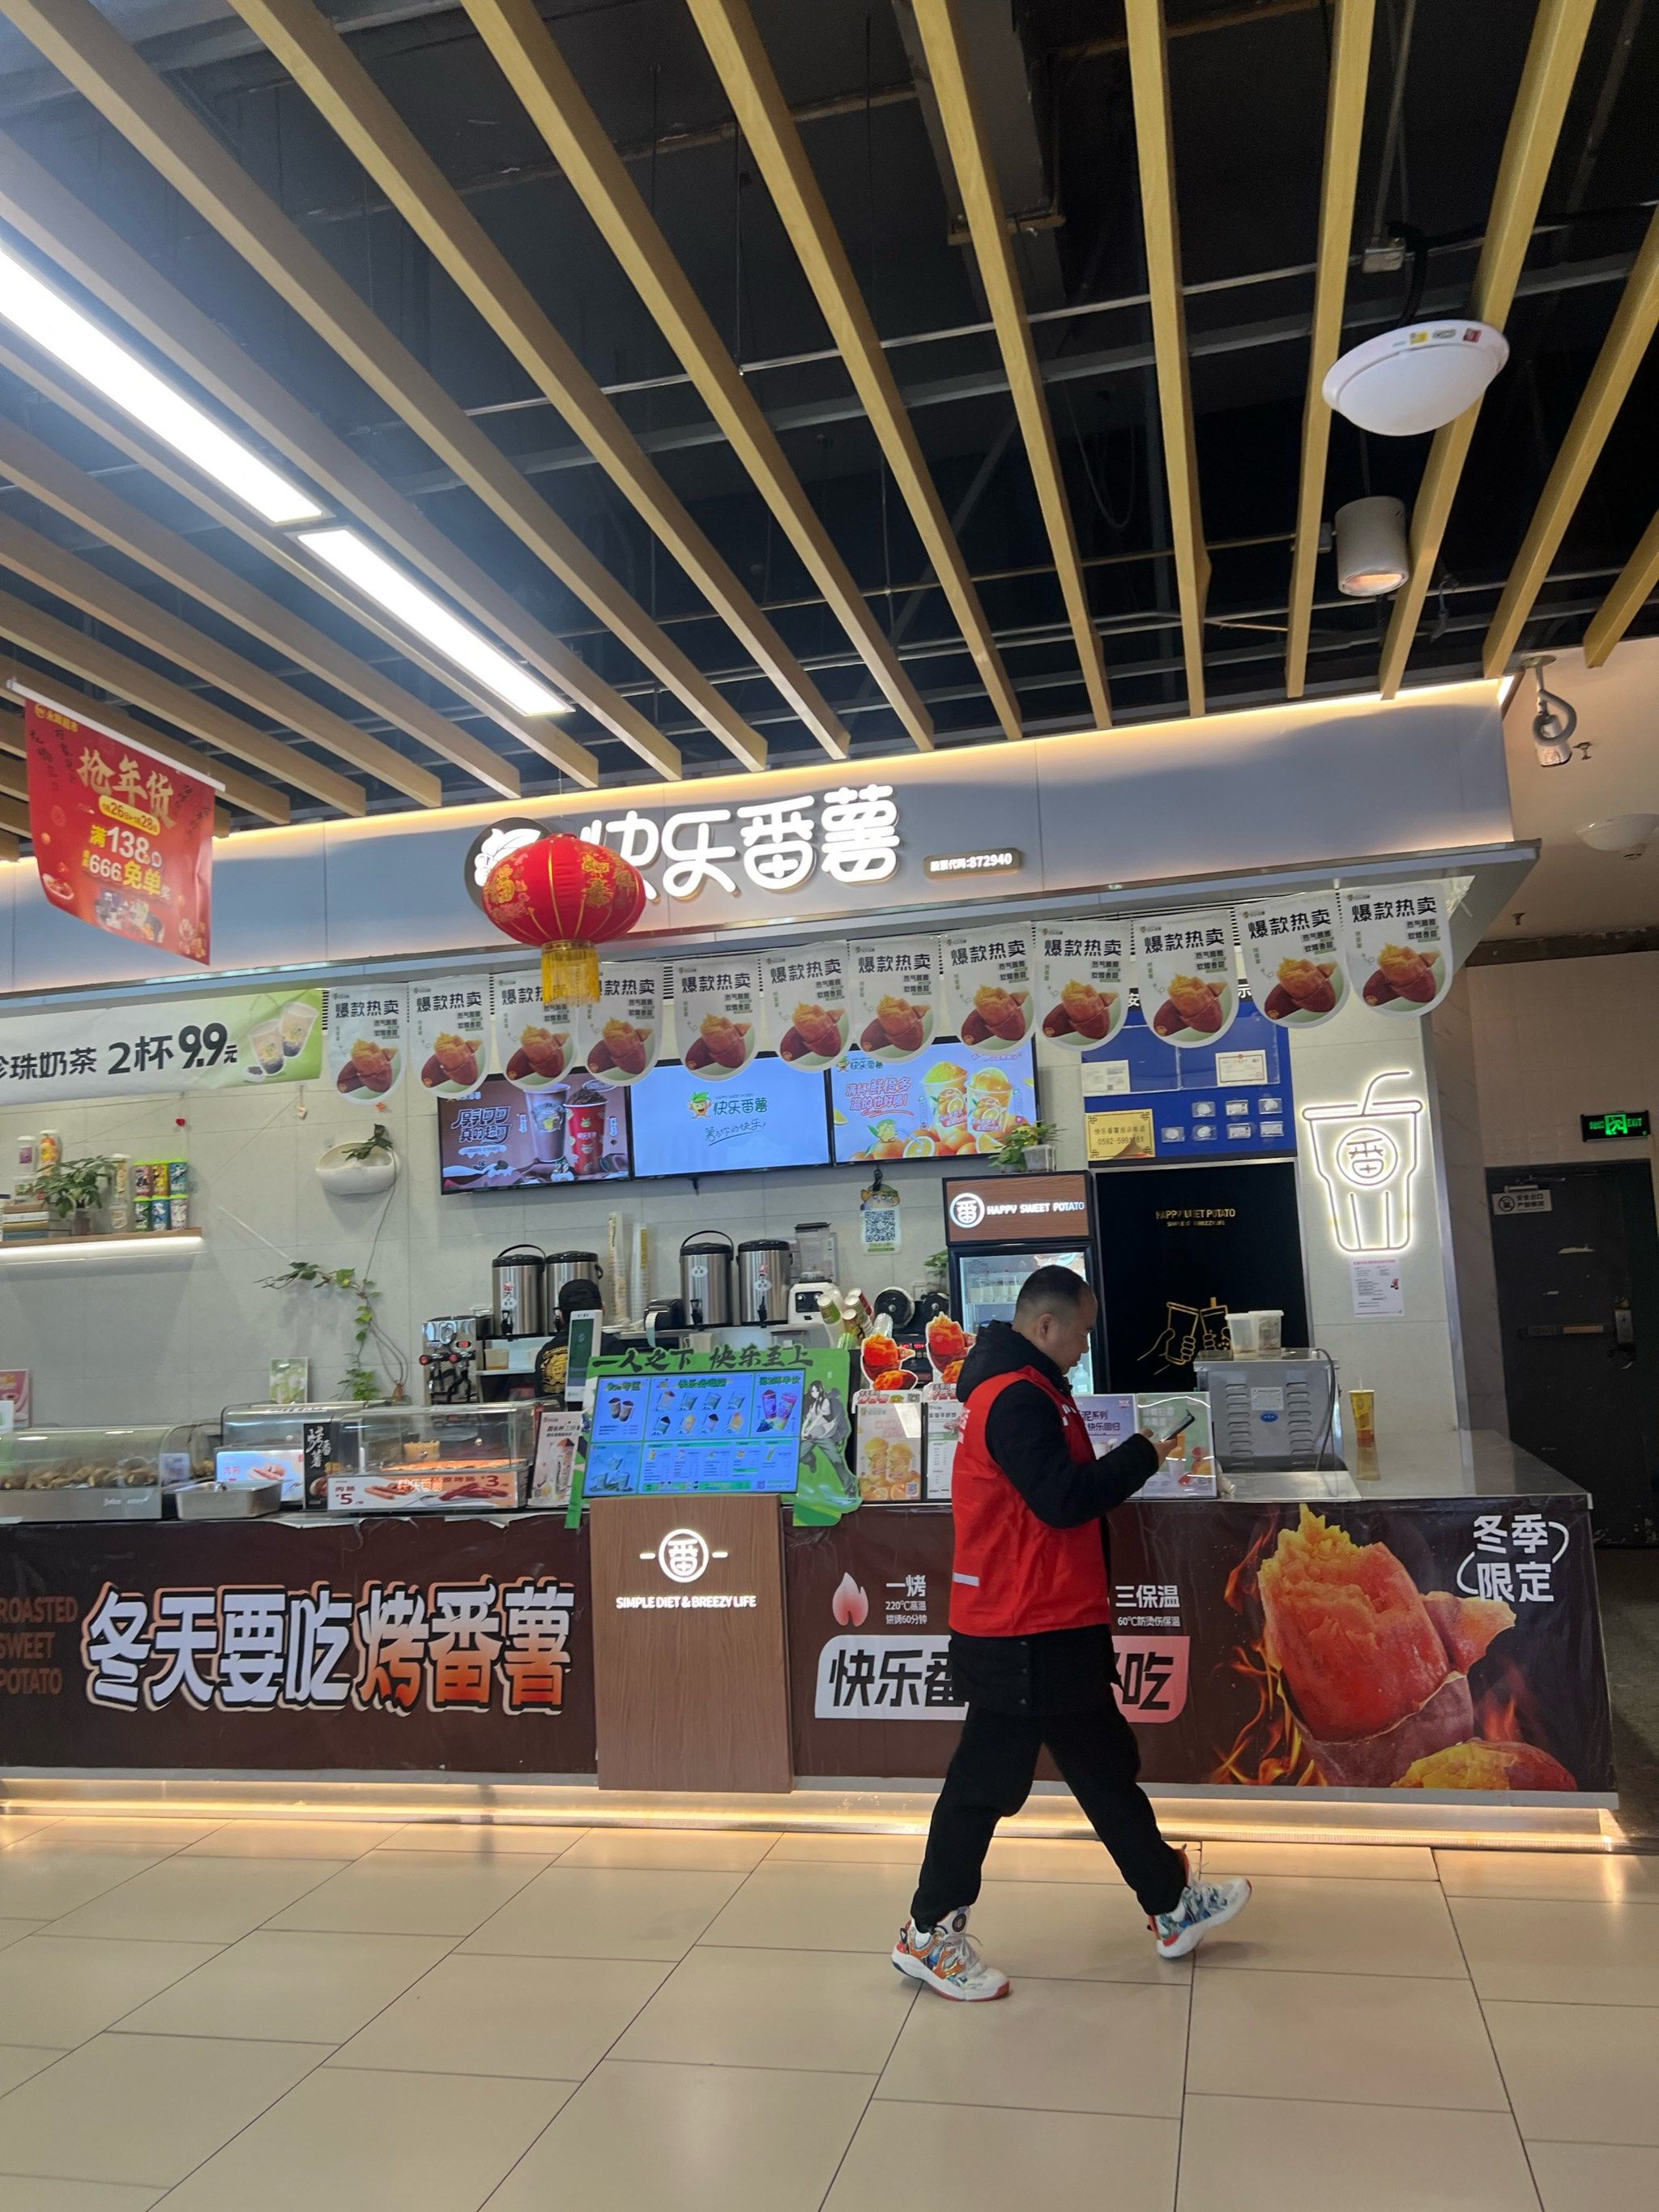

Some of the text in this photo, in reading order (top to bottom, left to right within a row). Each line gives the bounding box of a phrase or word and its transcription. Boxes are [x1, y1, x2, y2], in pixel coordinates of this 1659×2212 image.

[77, 747, 177, 829] 抢年货
[1351, 897, 1437, 924] 爆款热卖
[1248, 908, 1332, 940] 爆款热卖
[1044, 939, 1122, 957] 爆款热卖
[1144, 928, 1225, 954] 爆款热卖
[858, 953, 931, 974] 爆款热卖
[951, 940, 1026, 967] 爆款热卖
[770, 959, 842, 984] 爆款热卖
[599, 979, 655, 996] 款热卖
[681, 973, 752, 993] 爆款热卖
[335, 1000, 399, 1018] 爆款热卖
[416, 992, 482, 1013] 爆款热卖
[1128, 993, 1140, 1007] 安
[714, 1097, 768, 1115] 快乐番薯
[1346, 1137, 1384, 1178] 番
[987, 1202, 1085, 1215] HAPPY SWEET POTATO
[592, 1343, 814, 1373] 一人之下 快乐至上
[1087, 1422, 1120, 1432] 快乐回归
[1473, 1514, 1549, 1554] 冬季
[886, 1575, 926, 1597] 一烤
[1477, 1561, 1555, 1603] 限定
[616, 1595, 757, 1608] SIMPLE DIET & BREEZY LIFE
[1115, 1585, 1180, 1608] 三保温
[86, 1578, 575, 1711] 冬天要吃烤番薯
